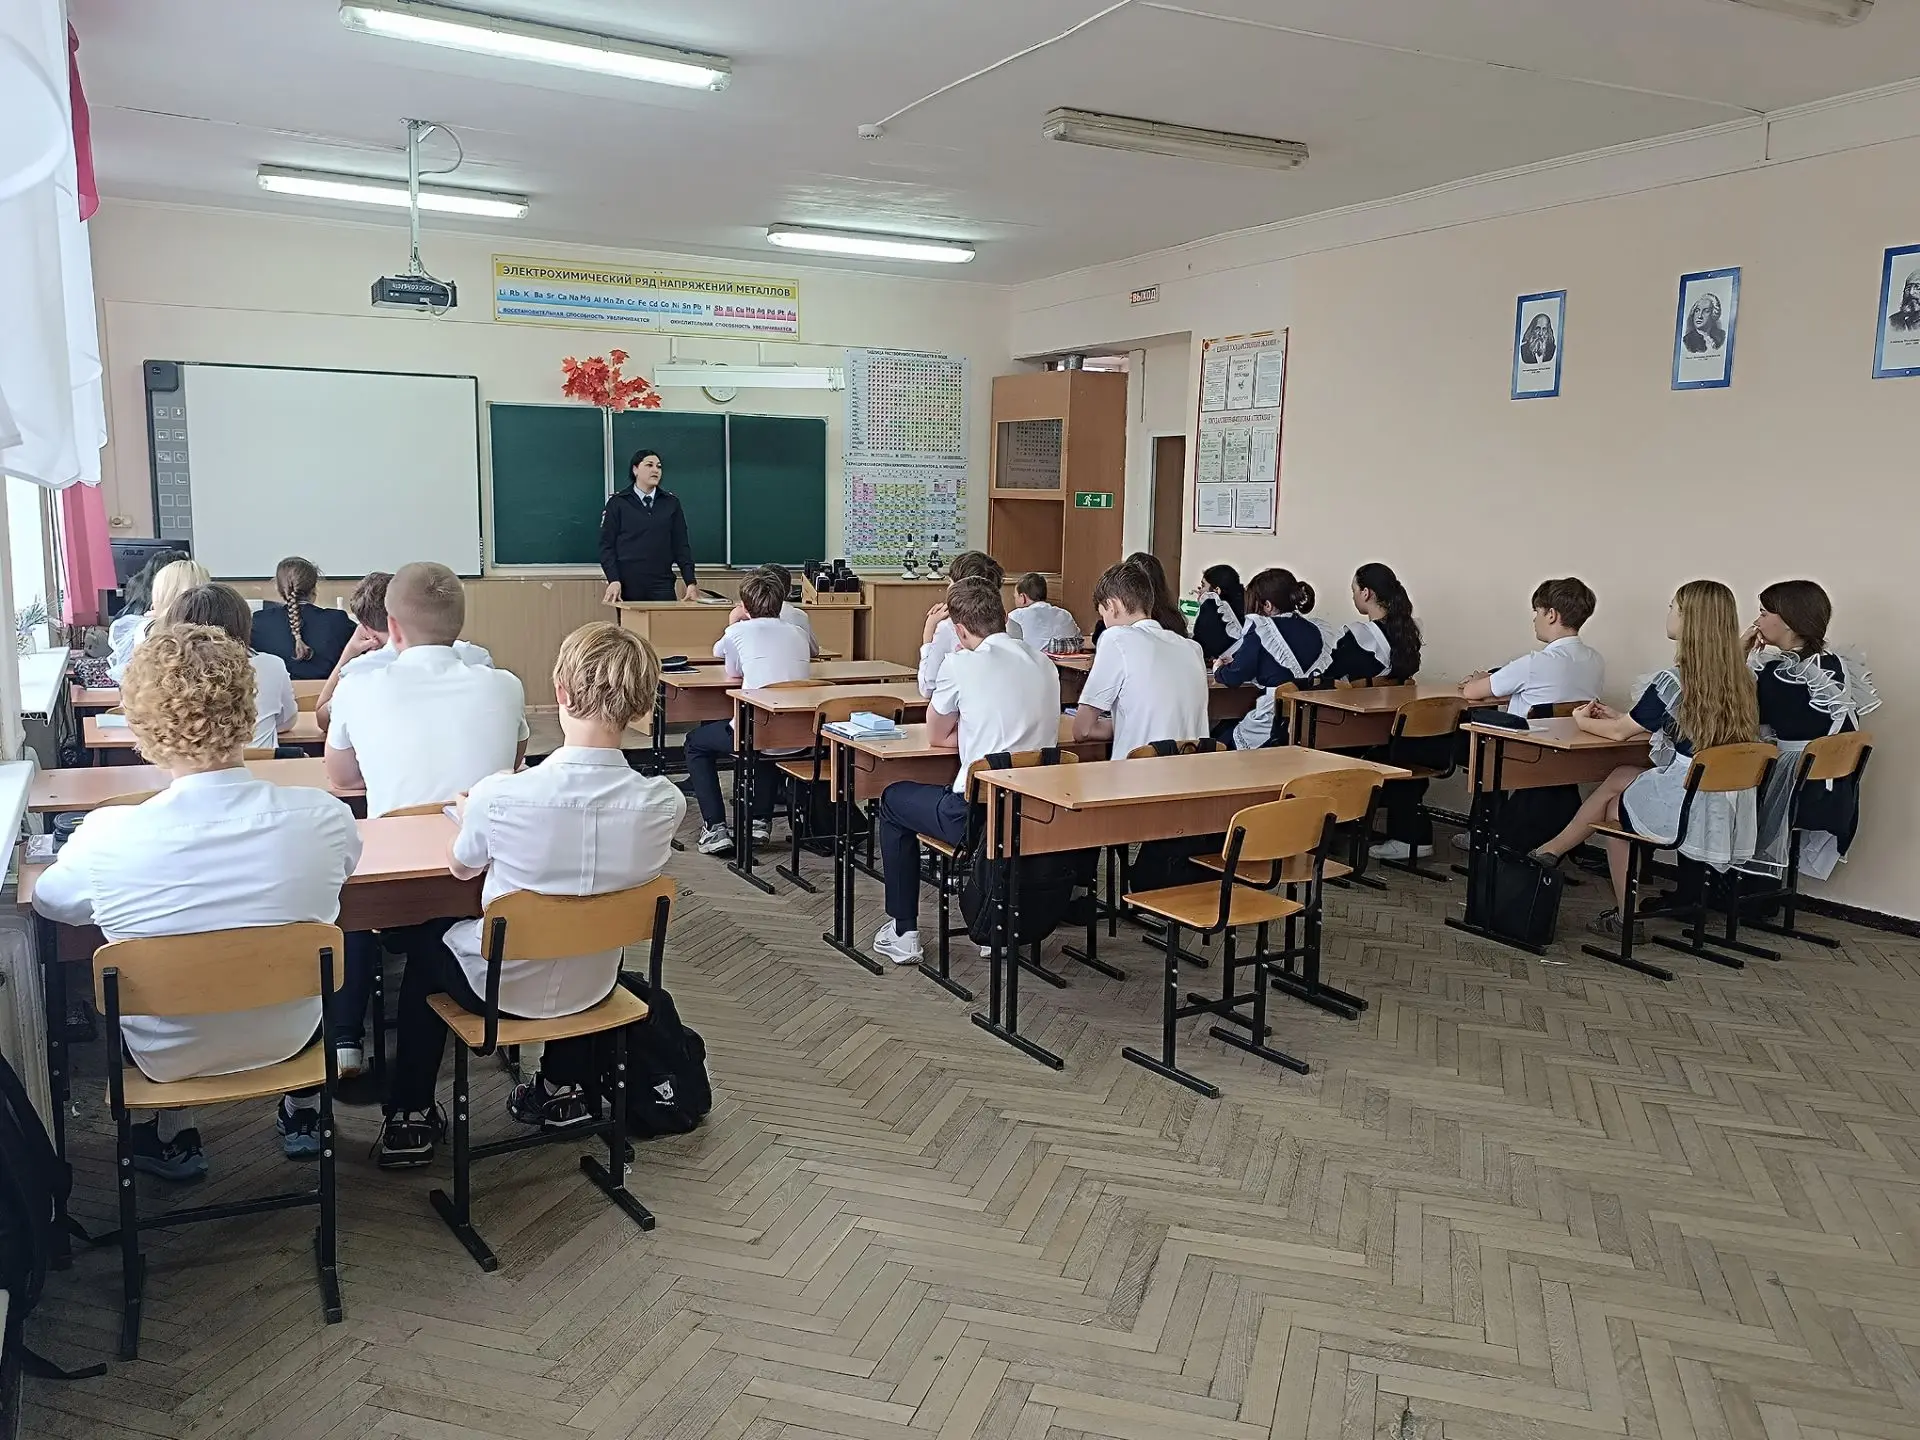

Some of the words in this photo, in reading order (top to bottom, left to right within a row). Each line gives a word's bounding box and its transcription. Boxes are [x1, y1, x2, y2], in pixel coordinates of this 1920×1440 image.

[503, 265, 632, 285] ЭЛЕКТРОХИМИЧЕСКИЙ
[635, 277, 657, 288] РЯД
[659, 279, 733, 292] НАПРЯЖЕНИЙ
[736, 285, 791, 297] МЕТАЛЛОВ
[1132, 289, 1156, 302] ВЫХОД
[503, 308, 564, 316] ВОССТАНОВИТЕЛЬНАЯ
[606, 315, 650, 323] УВЕЛИЧИВАЕТСЯ
[746, 307, 755, 315] Hg
[670, 319, 713, 327] ОКИСЛИТЕЛЬНАЯ
